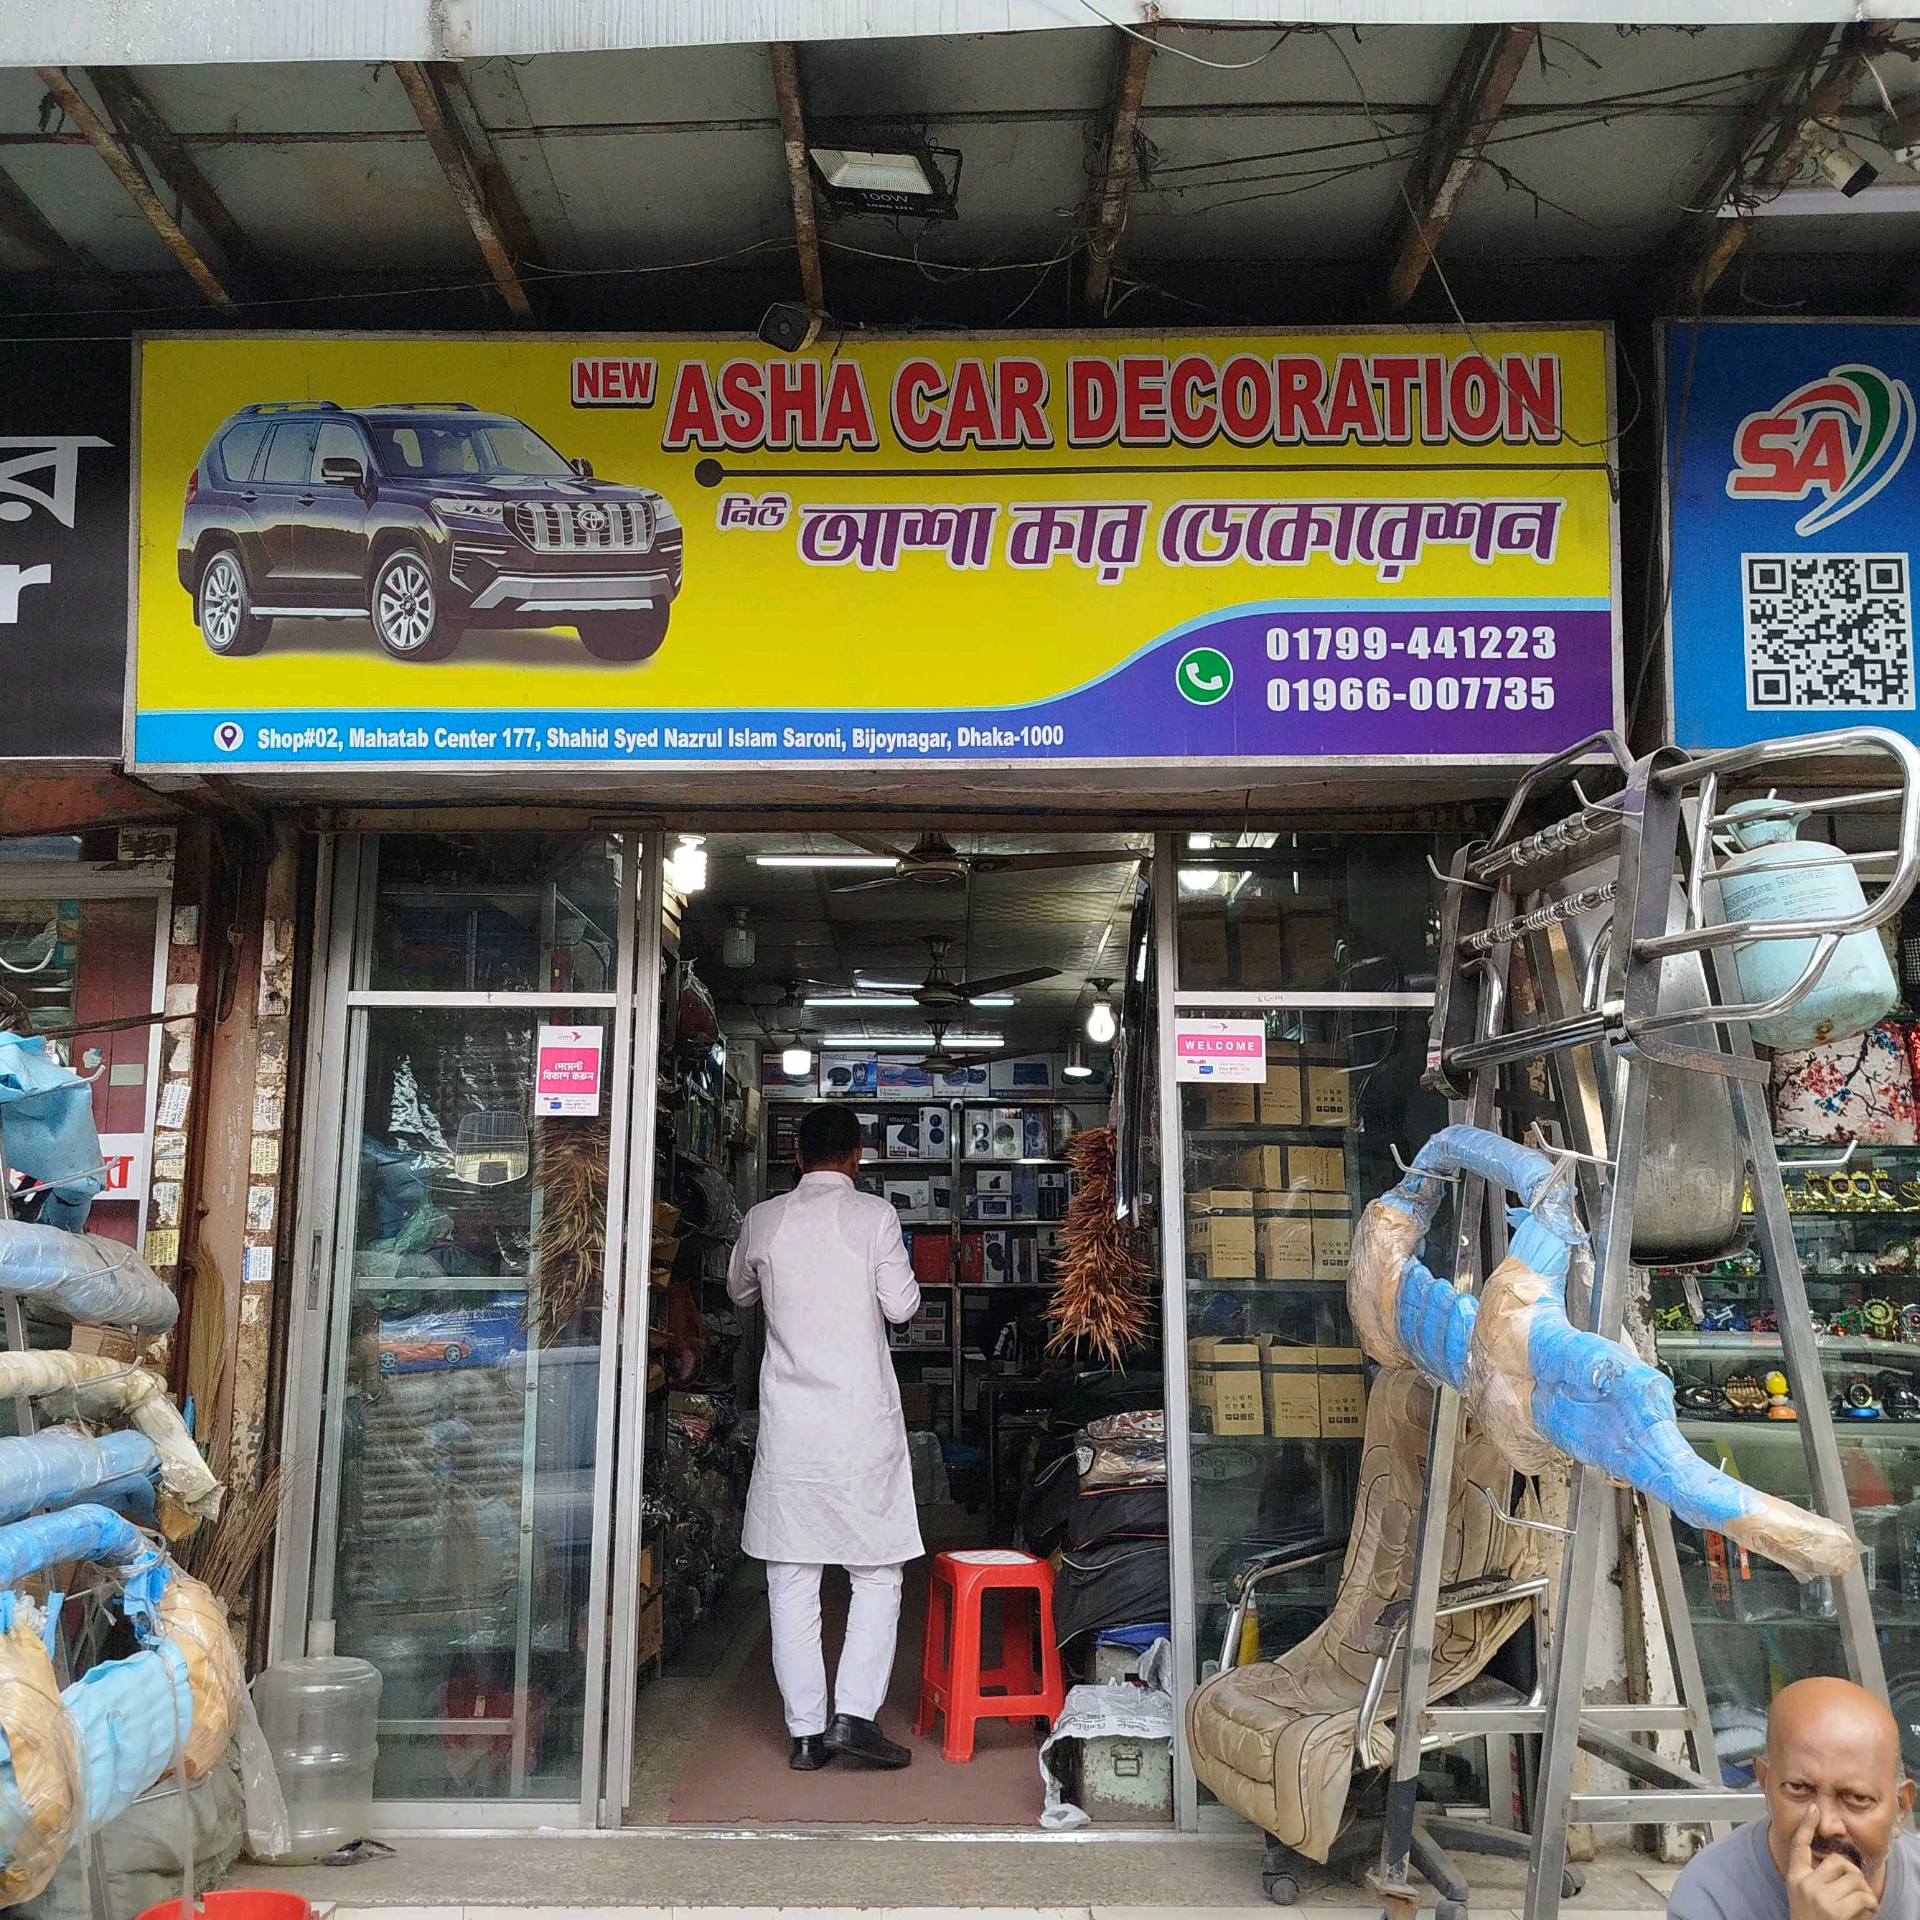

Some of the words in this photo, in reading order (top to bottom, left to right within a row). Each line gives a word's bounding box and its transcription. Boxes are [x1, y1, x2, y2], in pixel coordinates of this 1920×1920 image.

[860, 192, 908, 203] 100W
[574, 360, 655, 402] NEW
[664, 359, 878, 448] ASHA
[894, 358, 1052, 448] CAR
[1069, 354, 1561, 445] DECORATION
[1731, 416, 1848, 494] SA
[719, 495, 790, 529] নিউ
[798, 506, 999, 569] আশা
[1010, 503, 1150, 581] কার
[1159, 499, 1565, 581] ডেকোরেশন
[1266, 625, 1557, 661] 01799-441223
[1266, 676, 1556, 712] 01966-007735
[257, 728, 344, 752] Shop#02,
[349, 727, 429, 748] Mahatab
[434, 727, 497, 748] Center
[502, 727, 541, 752] 177,
[546, 727, 609, 748] Shahid
[614, 727, 658, 753] Syed
[664, 727, 723, 748] Nazrul
[729, 727, 778, 748] Islam
[783, 727, 846, 752] Saroni,
[852, 726, 952, 754] Bijoynagar,
[957, 725, 1064, 748] Dhaka-1000
[1184, 1039, 1256, 1052] WELCOME
[543, 1070, 570, 1081] বিকাশ
[571, 1072, 595, 1082] করুন
[554, 1060, 584, 1071] পেমেন্ট
